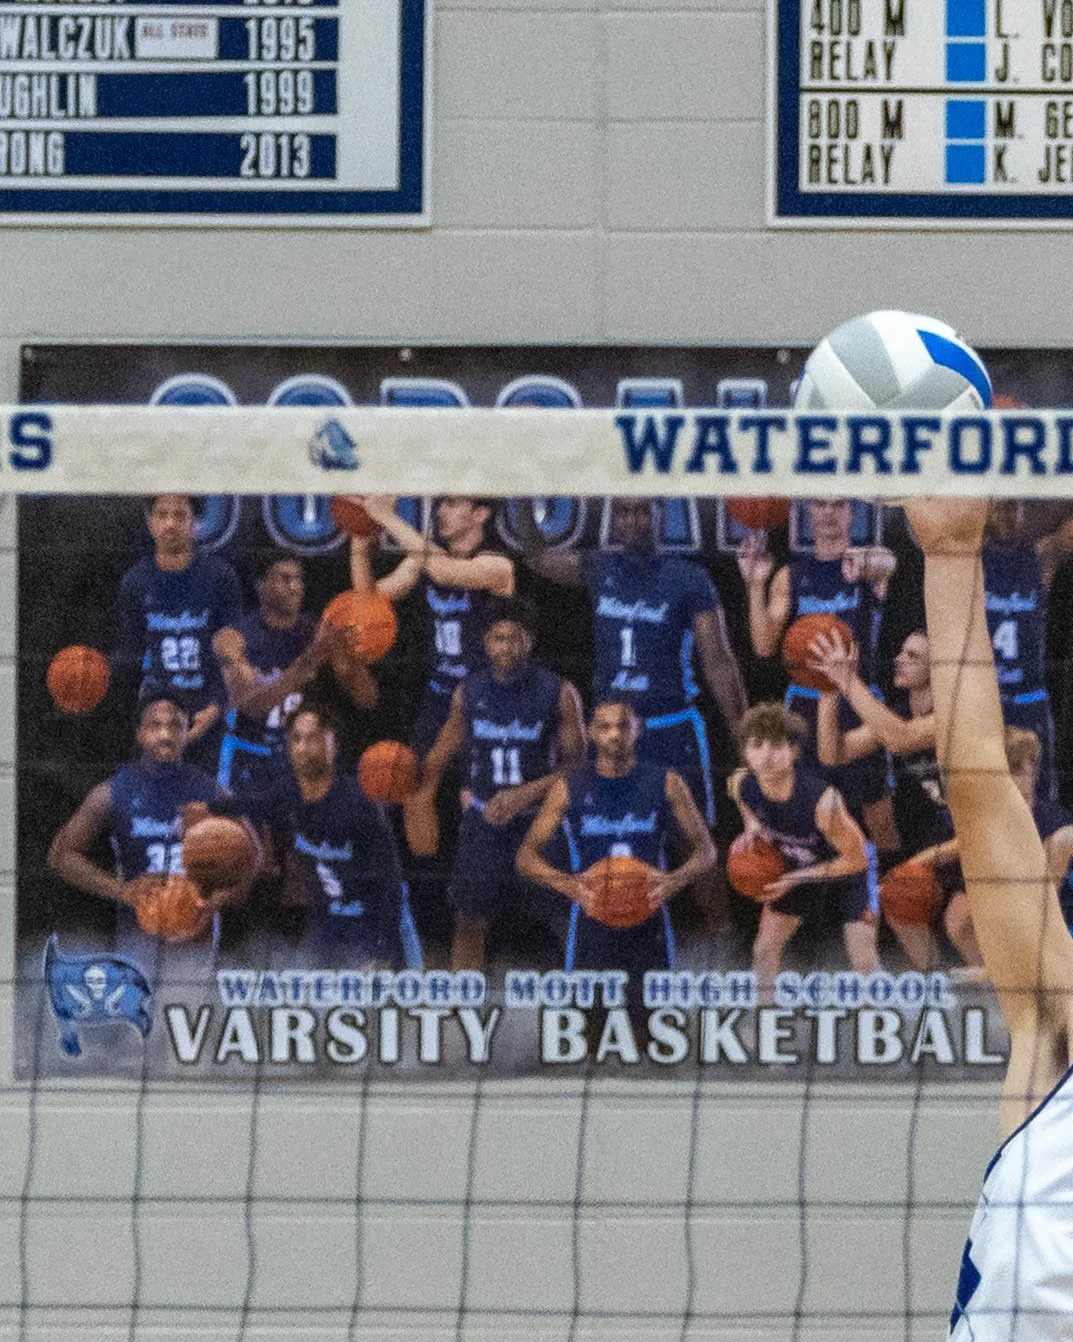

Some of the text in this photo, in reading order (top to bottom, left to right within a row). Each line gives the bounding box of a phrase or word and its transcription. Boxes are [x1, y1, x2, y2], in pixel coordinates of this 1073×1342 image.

[884, 0, 905, 36] M
[245, 17, 315, 61] 1995
[810, 40, 896, 81] RELAY
[244, 70, 314, 115] 1999
[808, 99, 903, 140] 800 M
[240, 133, 312, 177] 2013
[808, 144, 893, 184] RELAY
[216, 969, 958, 1009] WATERFORD MOTT HIGH SCHOOL
[167, 1006, 1005, 1064] VARSITY BASKETBAL
